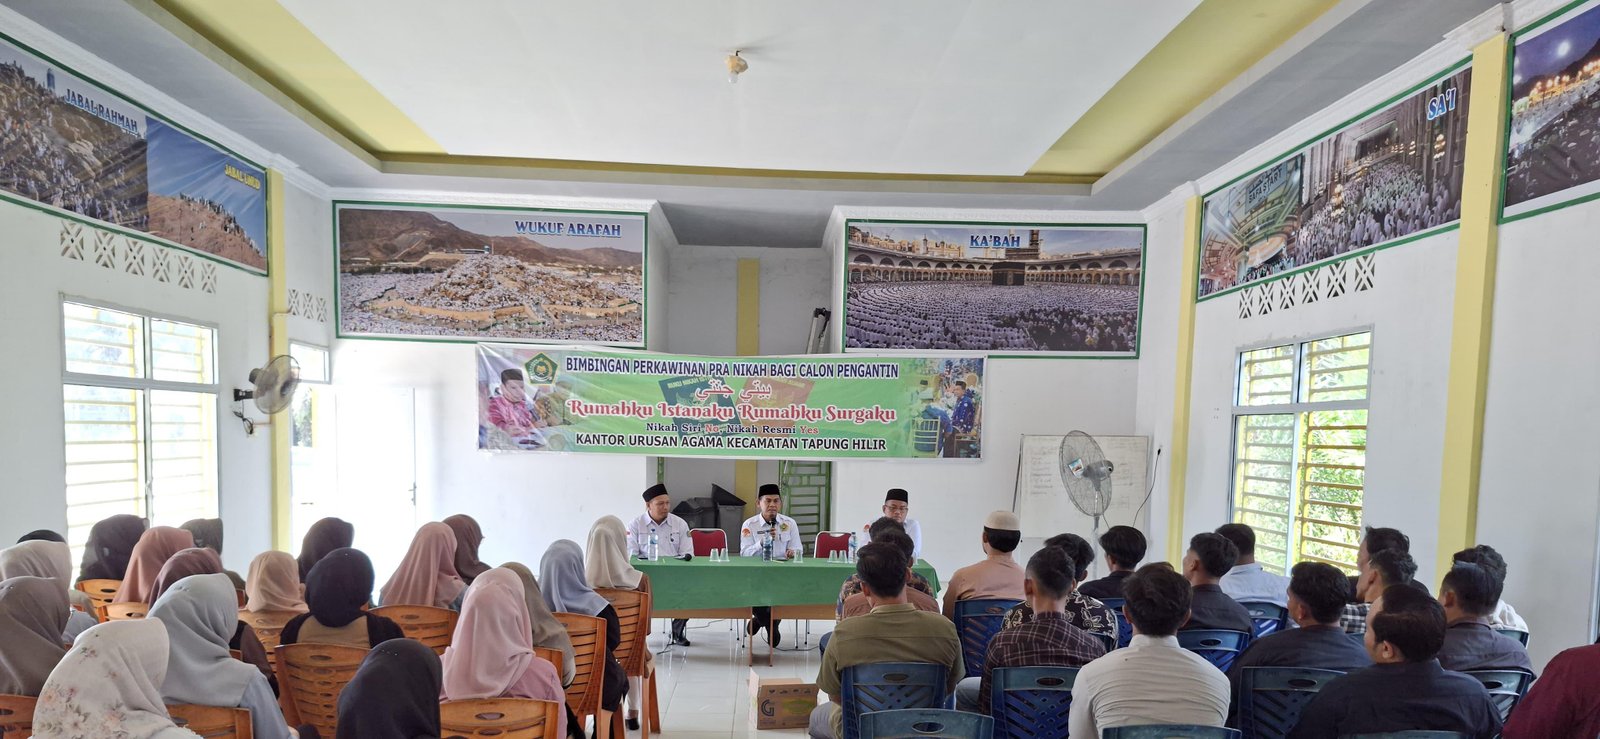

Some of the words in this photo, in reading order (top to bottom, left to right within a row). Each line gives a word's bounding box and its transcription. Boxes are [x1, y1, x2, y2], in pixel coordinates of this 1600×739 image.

[65, 88, 97, 115] JABAL
[98, 103, 138, 134] RAHMAH
[225, 163, 244, 182] JABAL
[515, 220, 564, 234] WUKUF
[567, 222, 621, 236] ARAFAH
[970, 234, 1020, 248] KA'BAH
[566, 357, 630, 373] BIMBINGAN
[633, 360, 705, 376] PERKAWINAN
[709, 362, 730, 376] PRA
[733, 363, 767, 377] NIKAH
[771, 364, 796, 377] BAGI
[800, 364, 834, 377] CALON
[837, 364, 899, 378] PENGANTIN
[567, 400, 653, 418] Rumahku
[657, 402, 733, 419] Istanaku
[738, 404, 822, 421] Rumahku
[826, 405, 896, 422] Surgaku
[646, 423, 677, 432] Nikah
[682, 423, 701, 432] Siri
[727, 424, 758, 433] Nikah
[762, 425, 796, 434] Resmi
[800, 425, 819, 434] Yes
[576, 434, 625, 445] KANTOR
[629, 435, 677, 447] URUSAN
[681, 436, 724, 448] AGAMA
[727, 437, 798, 449] KECAMATAN
[802, 438, 849, 449] TAPUNG
[852, 439, 887, 450] HILIR
